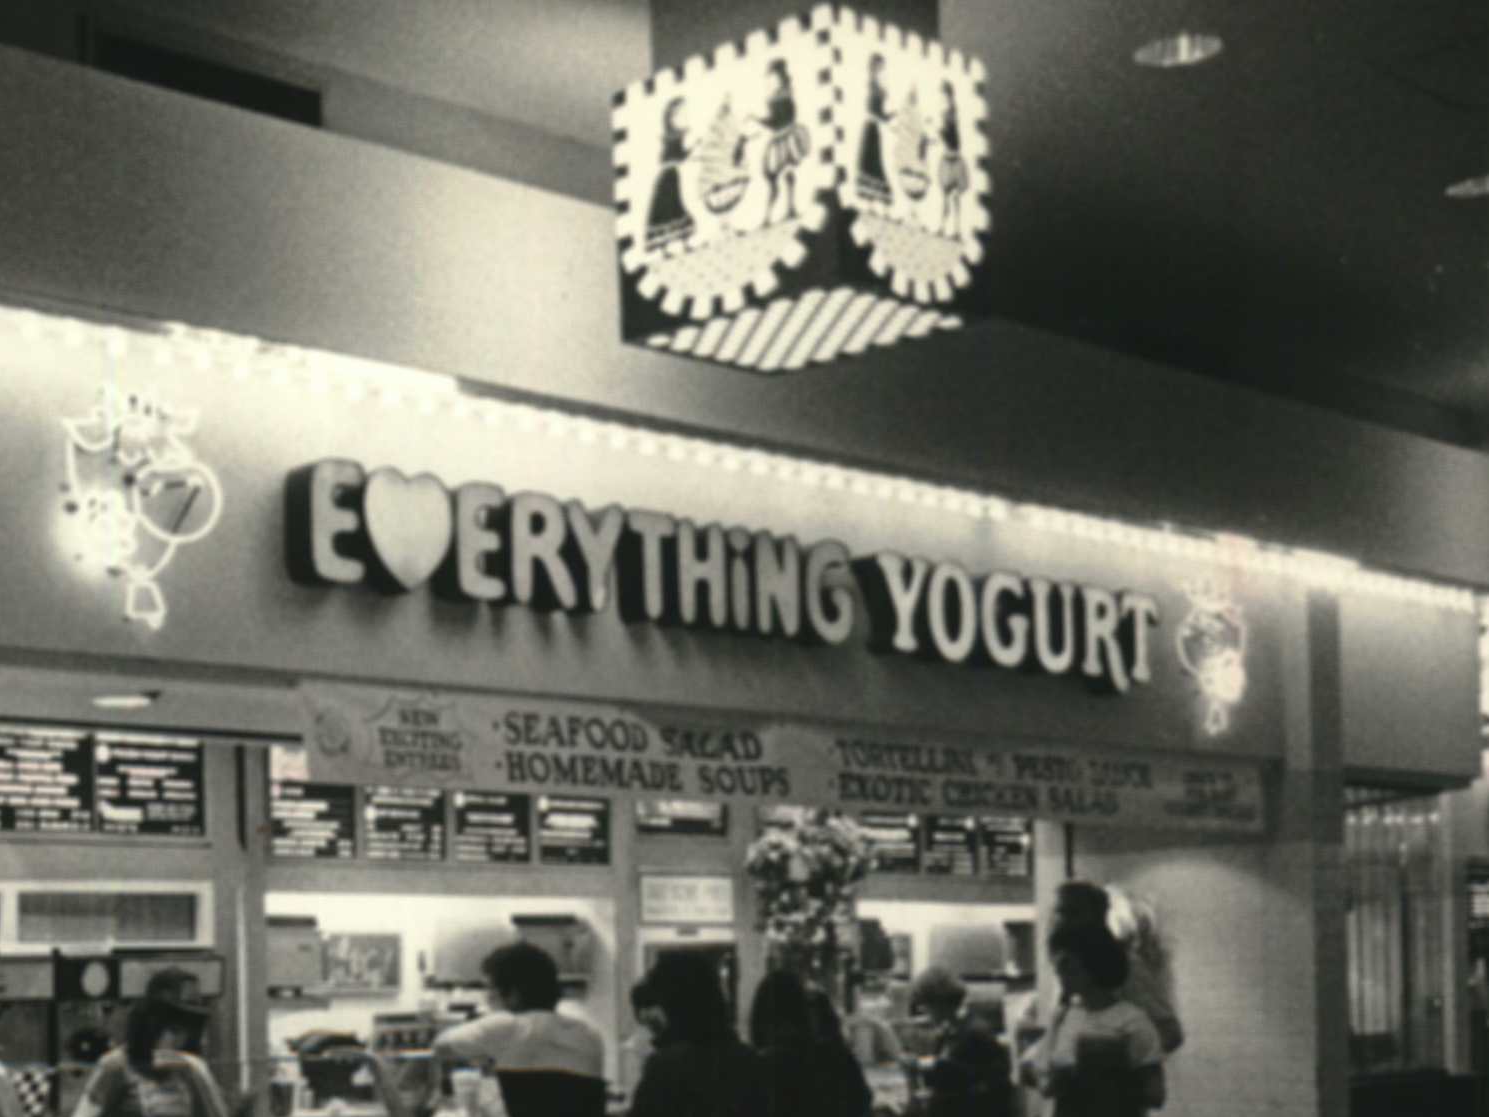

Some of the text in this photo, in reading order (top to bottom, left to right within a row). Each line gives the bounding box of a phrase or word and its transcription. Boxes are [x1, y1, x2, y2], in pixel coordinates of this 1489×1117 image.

[874, 549, 1159, 693] YOGURT
[502, 711, 763, 762] SEAFOOD SALAD
[504, 750, 791, 797] HOMEMADE SOUPS
[838, 772, 932, 806] EXOTIC
